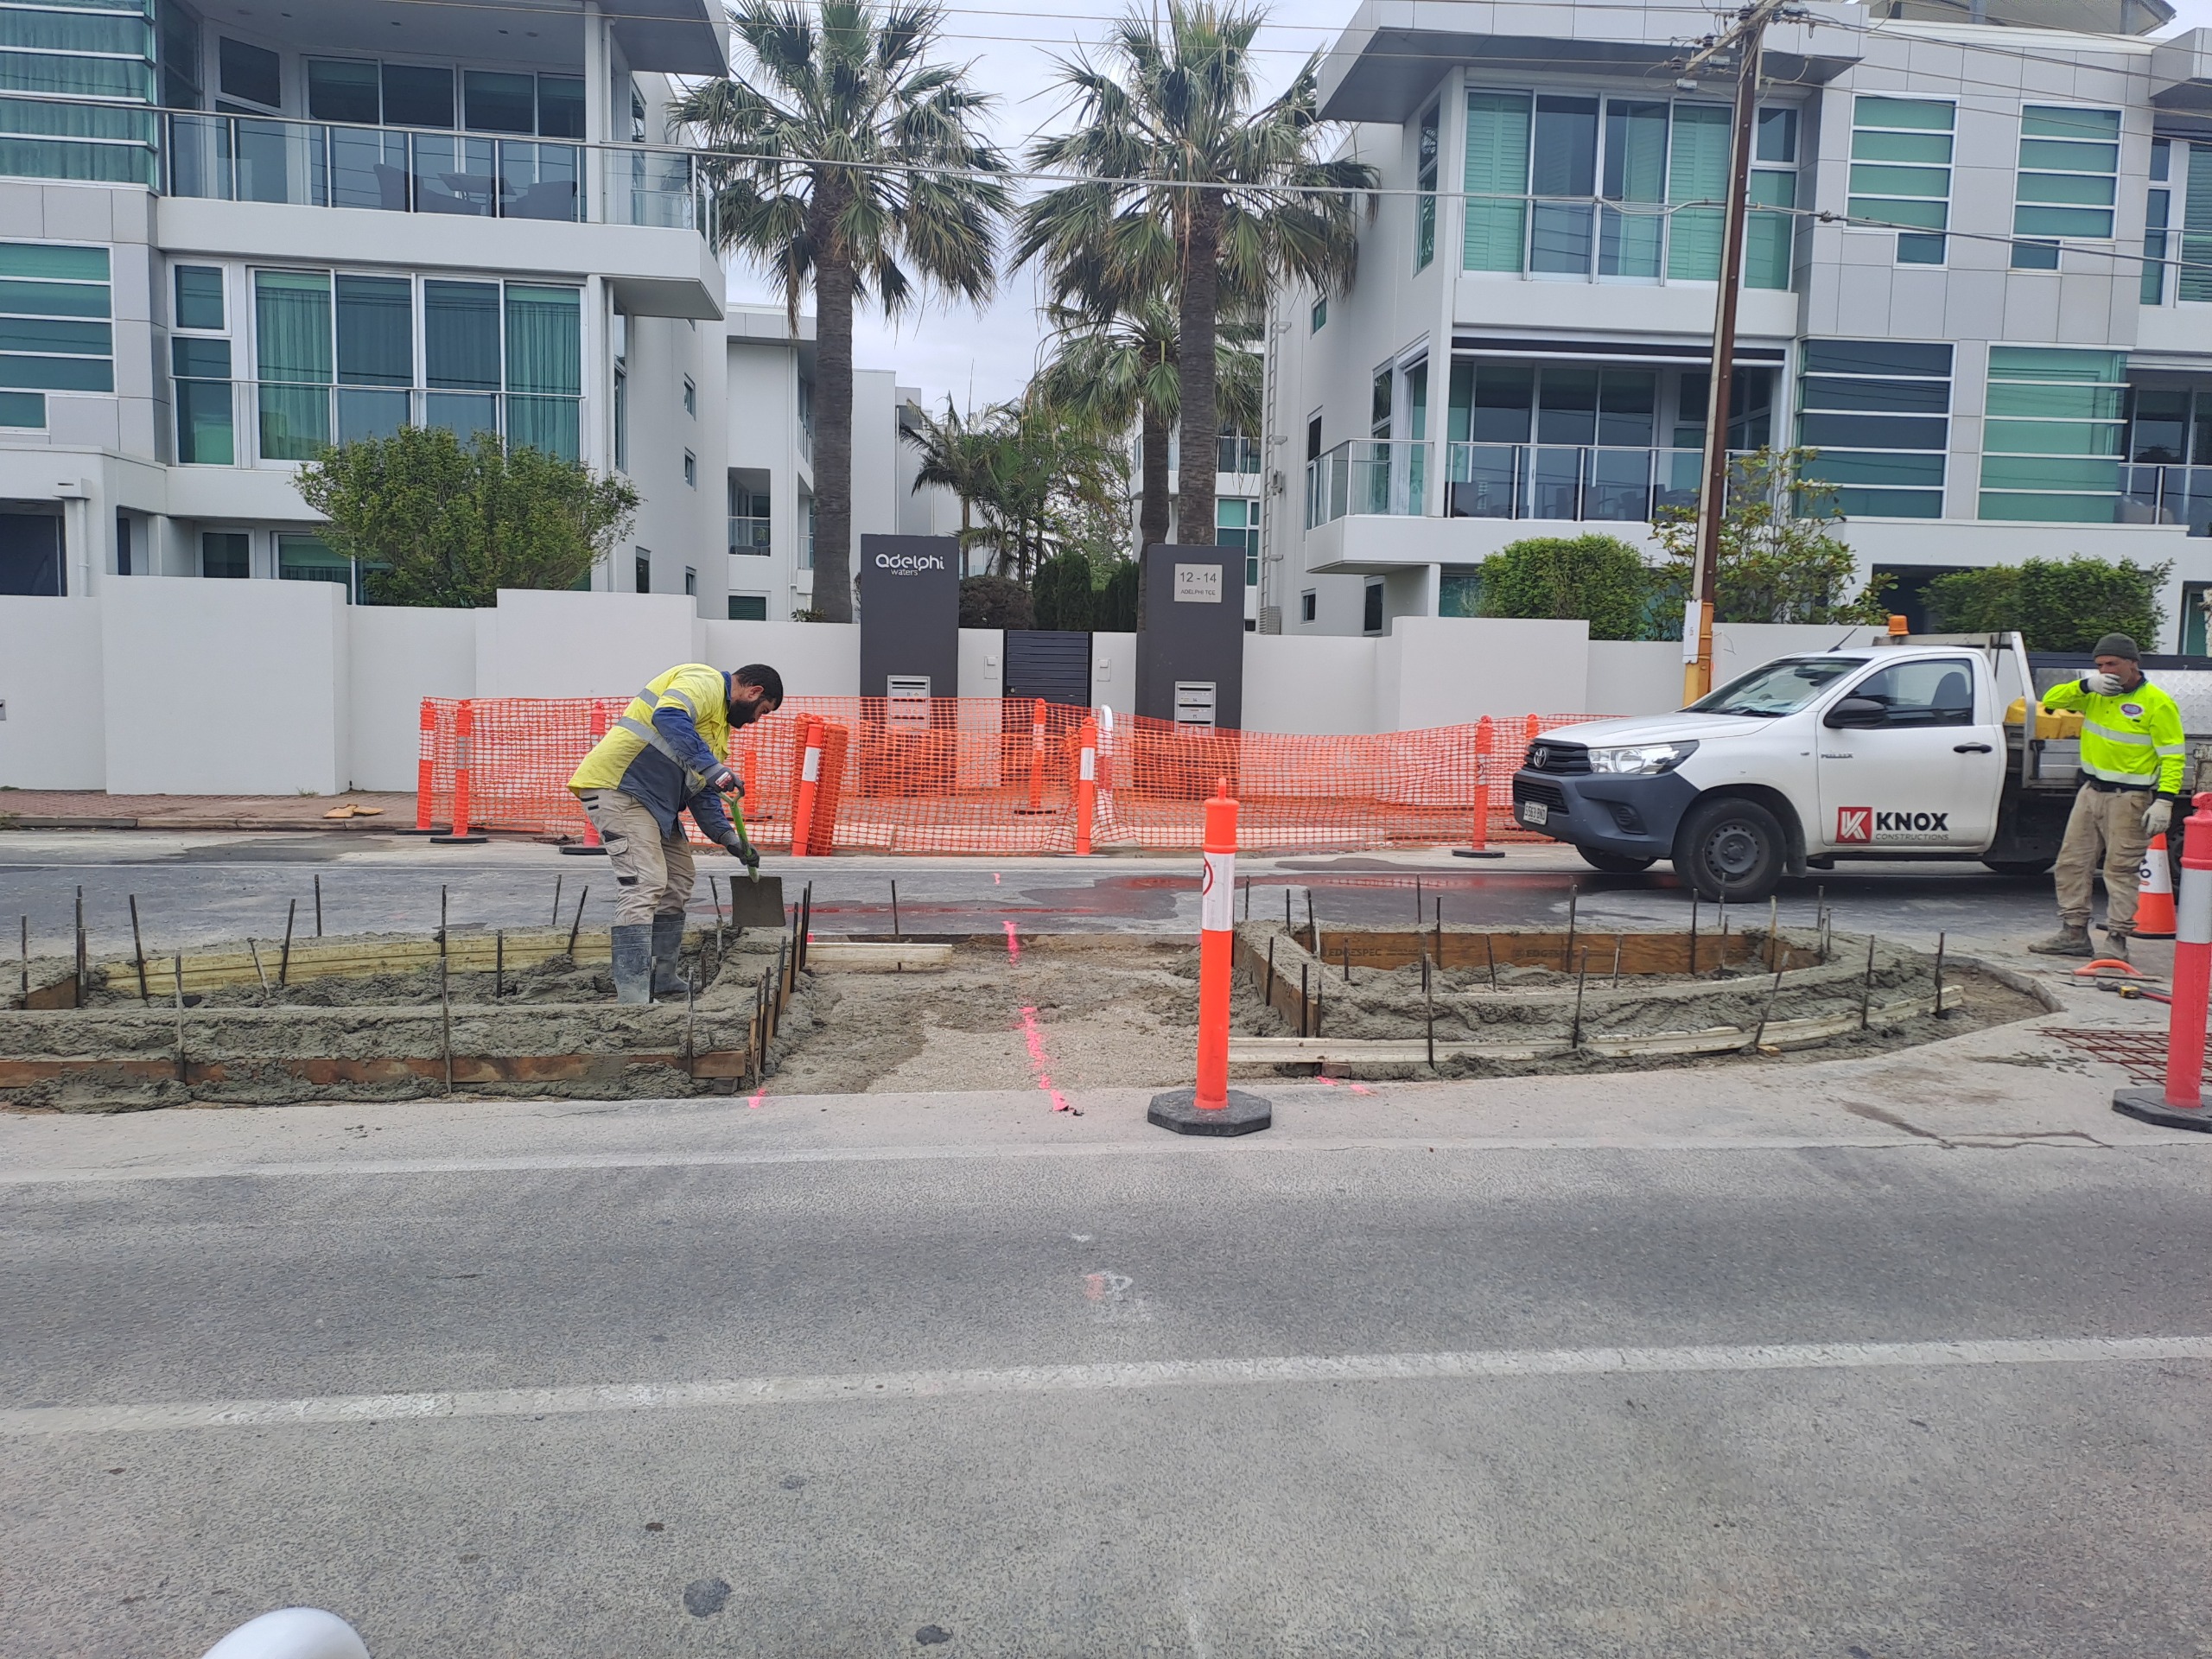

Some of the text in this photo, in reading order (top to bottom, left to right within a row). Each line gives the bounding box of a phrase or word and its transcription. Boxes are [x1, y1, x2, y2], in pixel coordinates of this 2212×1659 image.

[1180, 571, 1193, 582] 12
[1204, 572, 1217, 583] 14
[1876, 811, 1949, 831] KNOX
